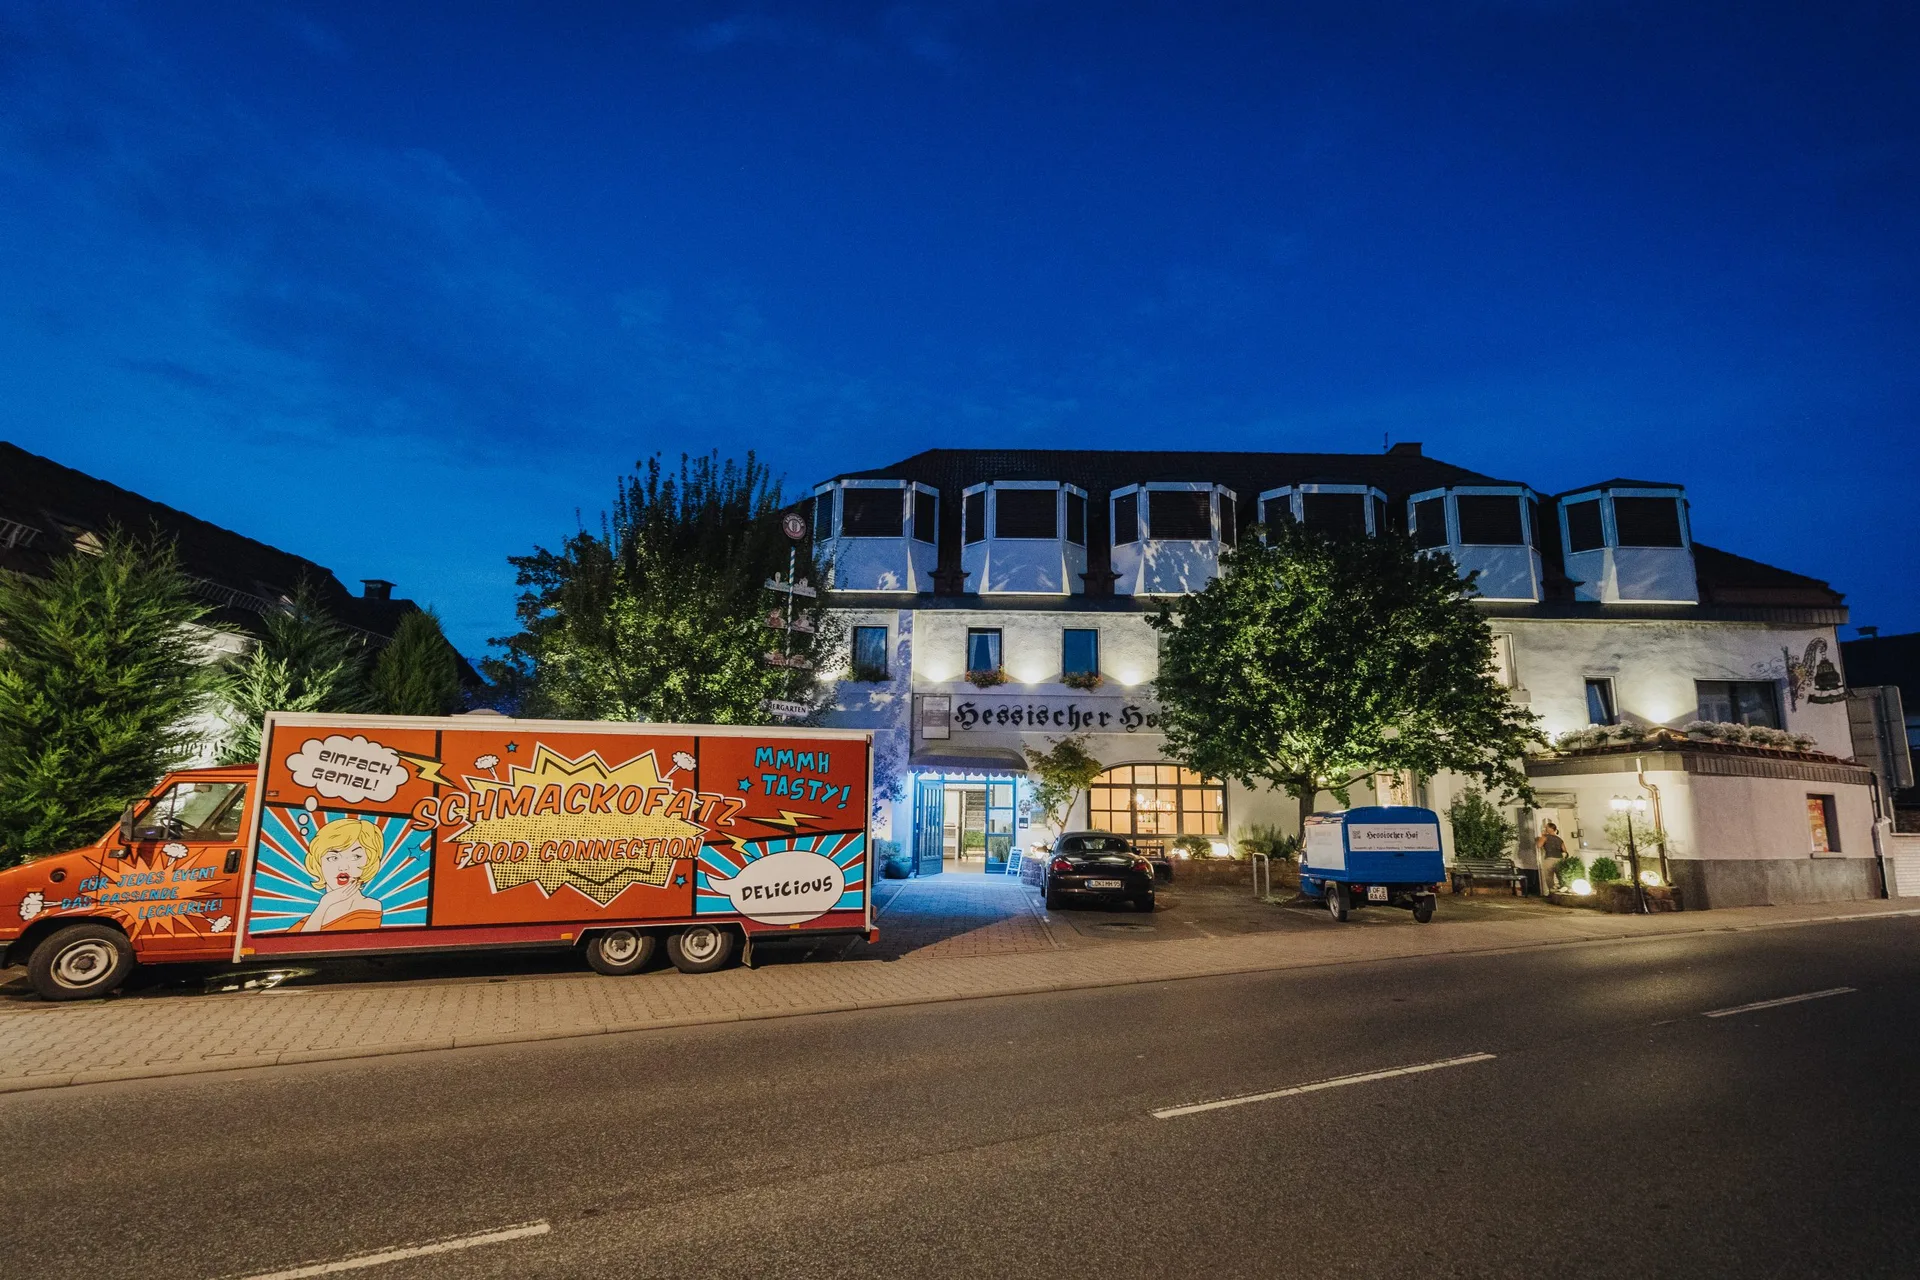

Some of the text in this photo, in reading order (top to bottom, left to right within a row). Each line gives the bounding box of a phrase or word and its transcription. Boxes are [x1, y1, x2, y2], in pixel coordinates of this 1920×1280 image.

[954, 701, 1112, 731] Hessischer
[754, 746, 830, 774] MMMH
[761, 773, 851, 809] TASTY!
[411, 782, 745, 831] SCHMACKOFATZ
[455, 837, 703, 865] FOOD CONNECTION
[79, 866, 218, 891] FÜR JEDES EVENT
[61, 887, 179, 910] DAS PASSENDE
[138, 899, 223, 919] LECKERLIE!
